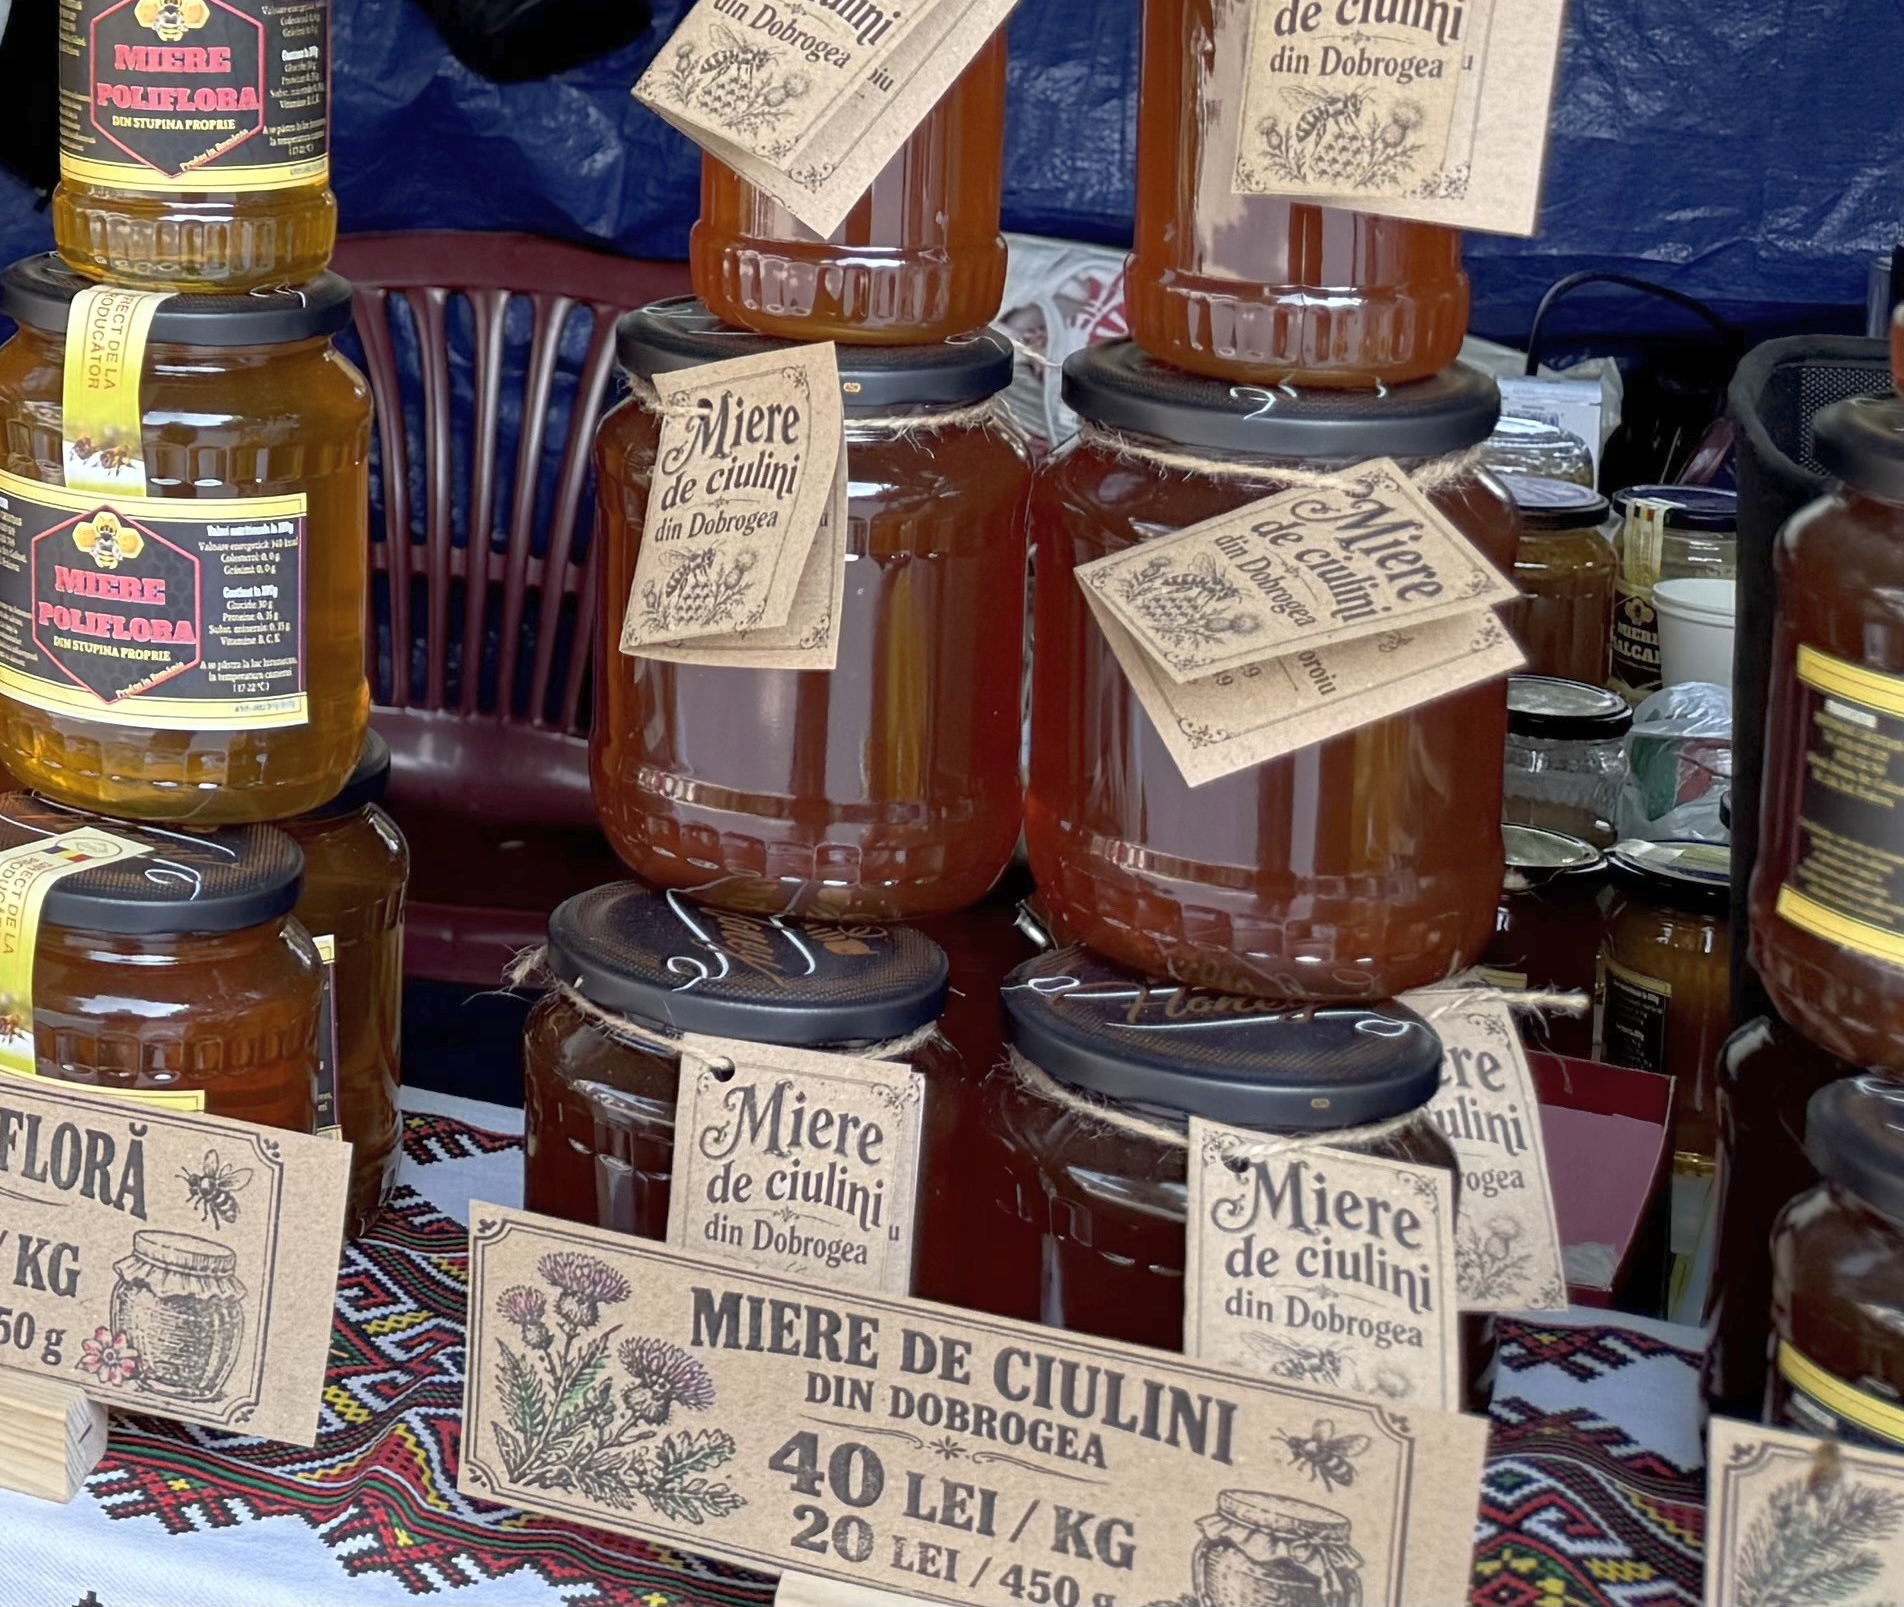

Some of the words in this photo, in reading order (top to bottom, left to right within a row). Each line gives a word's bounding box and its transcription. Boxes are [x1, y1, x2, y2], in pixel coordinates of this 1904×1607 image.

[114, 45, 231, 73] MIERE
[749, 4, 852, 69] Dobrogea
[1270, 45, 1309, 74] din
[1318, 46, 1444, 85] Dobrogea
[97, 83, 260, 111] POLIFLORA
[661, 390, 800, 476] Miere
[660, 472, 697, 512] de
[706, 450, 800, 500] ciulini
[655, 518, 683, 542] din
[687, 510, 779, 536] Dobrogea
[54, 565, 166, 605] MIERE
[38, 601, 197, 644] POLIFLORA
[53, 635, 73, 649] DIN
[73, 640, 120, 658] STUPINA
[120, 647, 171, 662] PROPRIE
[12, 1233, 82, 1298] KG
[41, 1328, 68, 1366] g
[690, 1286, 880, 1370] MIERE
[899, 1328, 973, 1386] DE
[993, 1346, 1238, 1466] CIULINI
[804, 1370, 875, 1413] DIN
[889, 1384, 1109, 1470] DOBROGEA
[767, 1430, 886, 1509] 40
[903, 1470, 998, 1537] LEI
[1049, 1504, 1138, 1572] KG
[791, 1504, 875, 1564] 20
[891, 1535, 961, 1583] LEI
[999, 1563, 1083, 1607] 450
